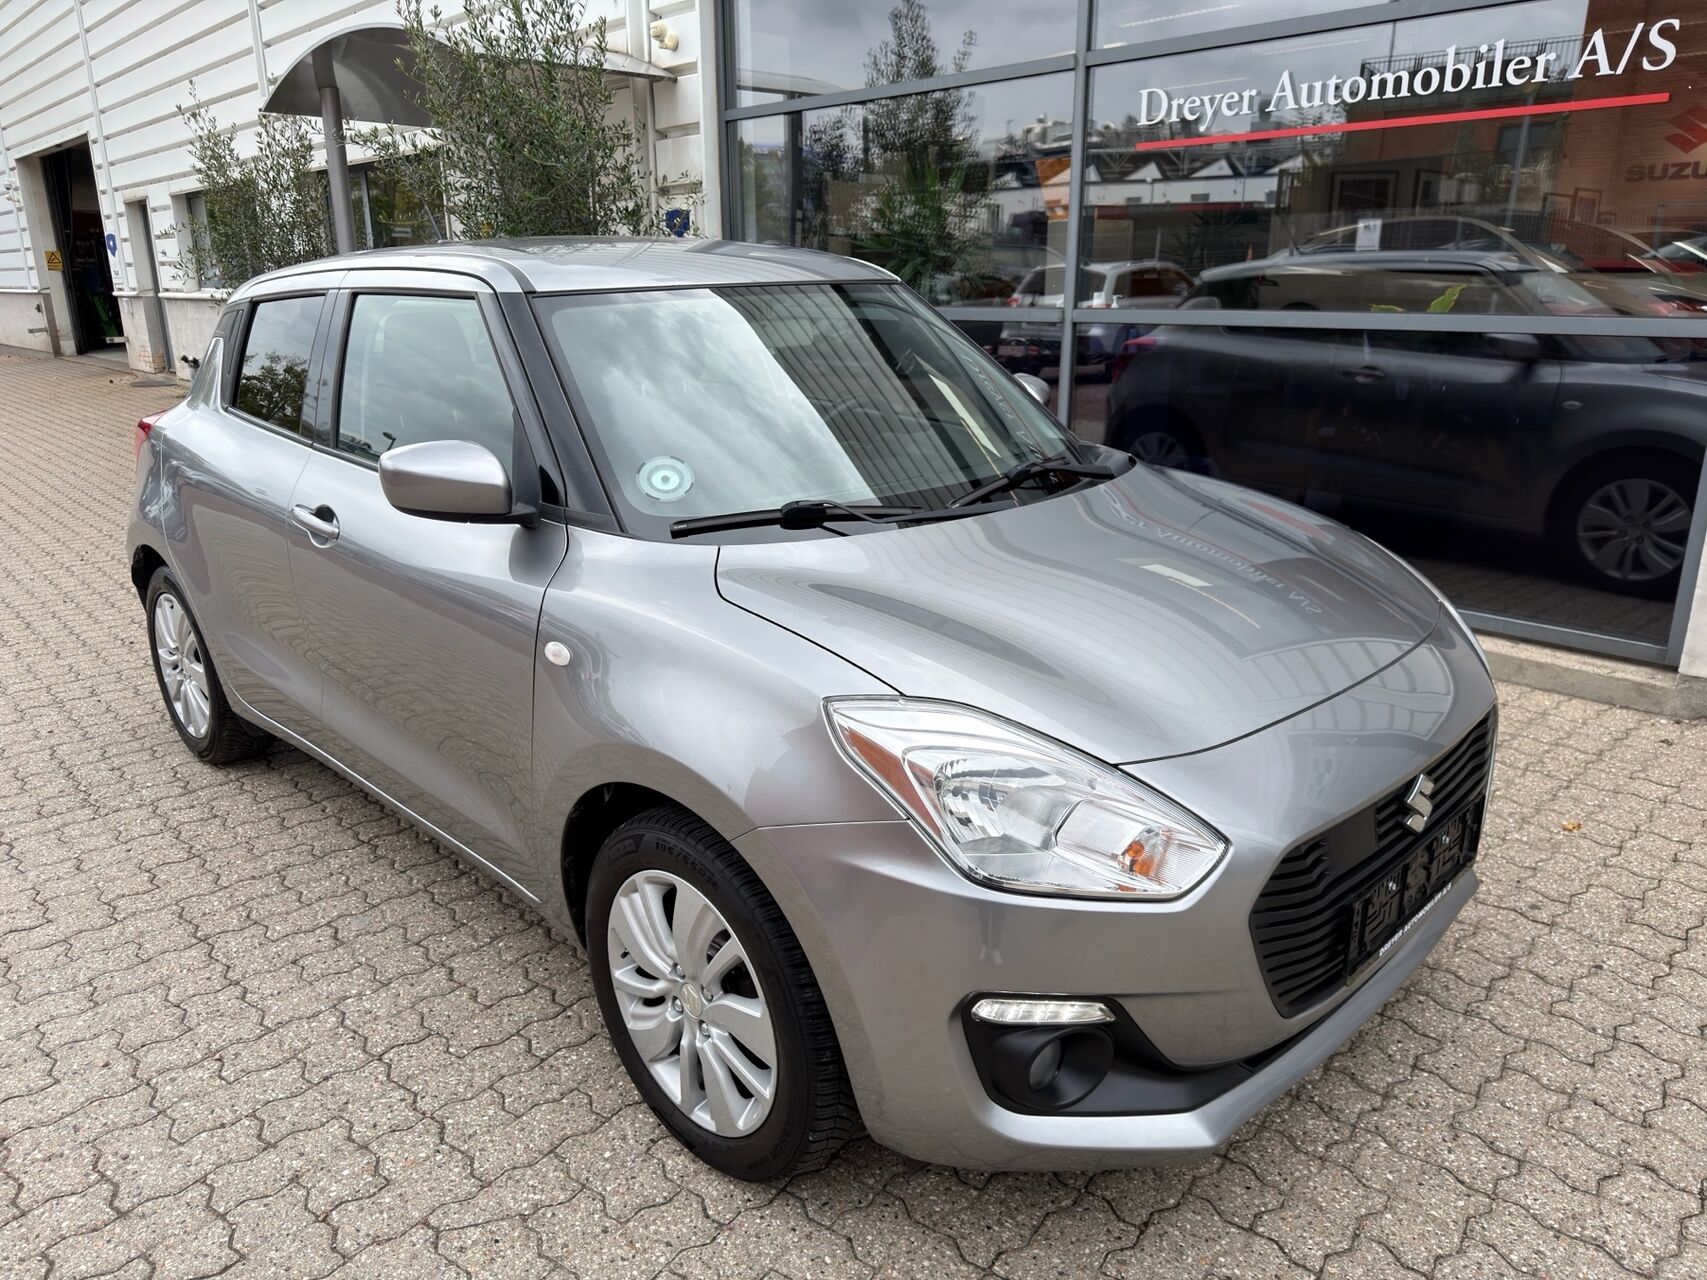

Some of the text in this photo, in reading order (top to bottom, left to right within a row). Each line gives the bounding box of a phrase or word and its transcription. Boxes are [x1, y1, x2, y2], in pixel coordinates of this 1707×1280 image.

[1137, 18, 1681, 132] Dreyer Automobiler A/S
[1625, 161, 1707, 182] SUZU
